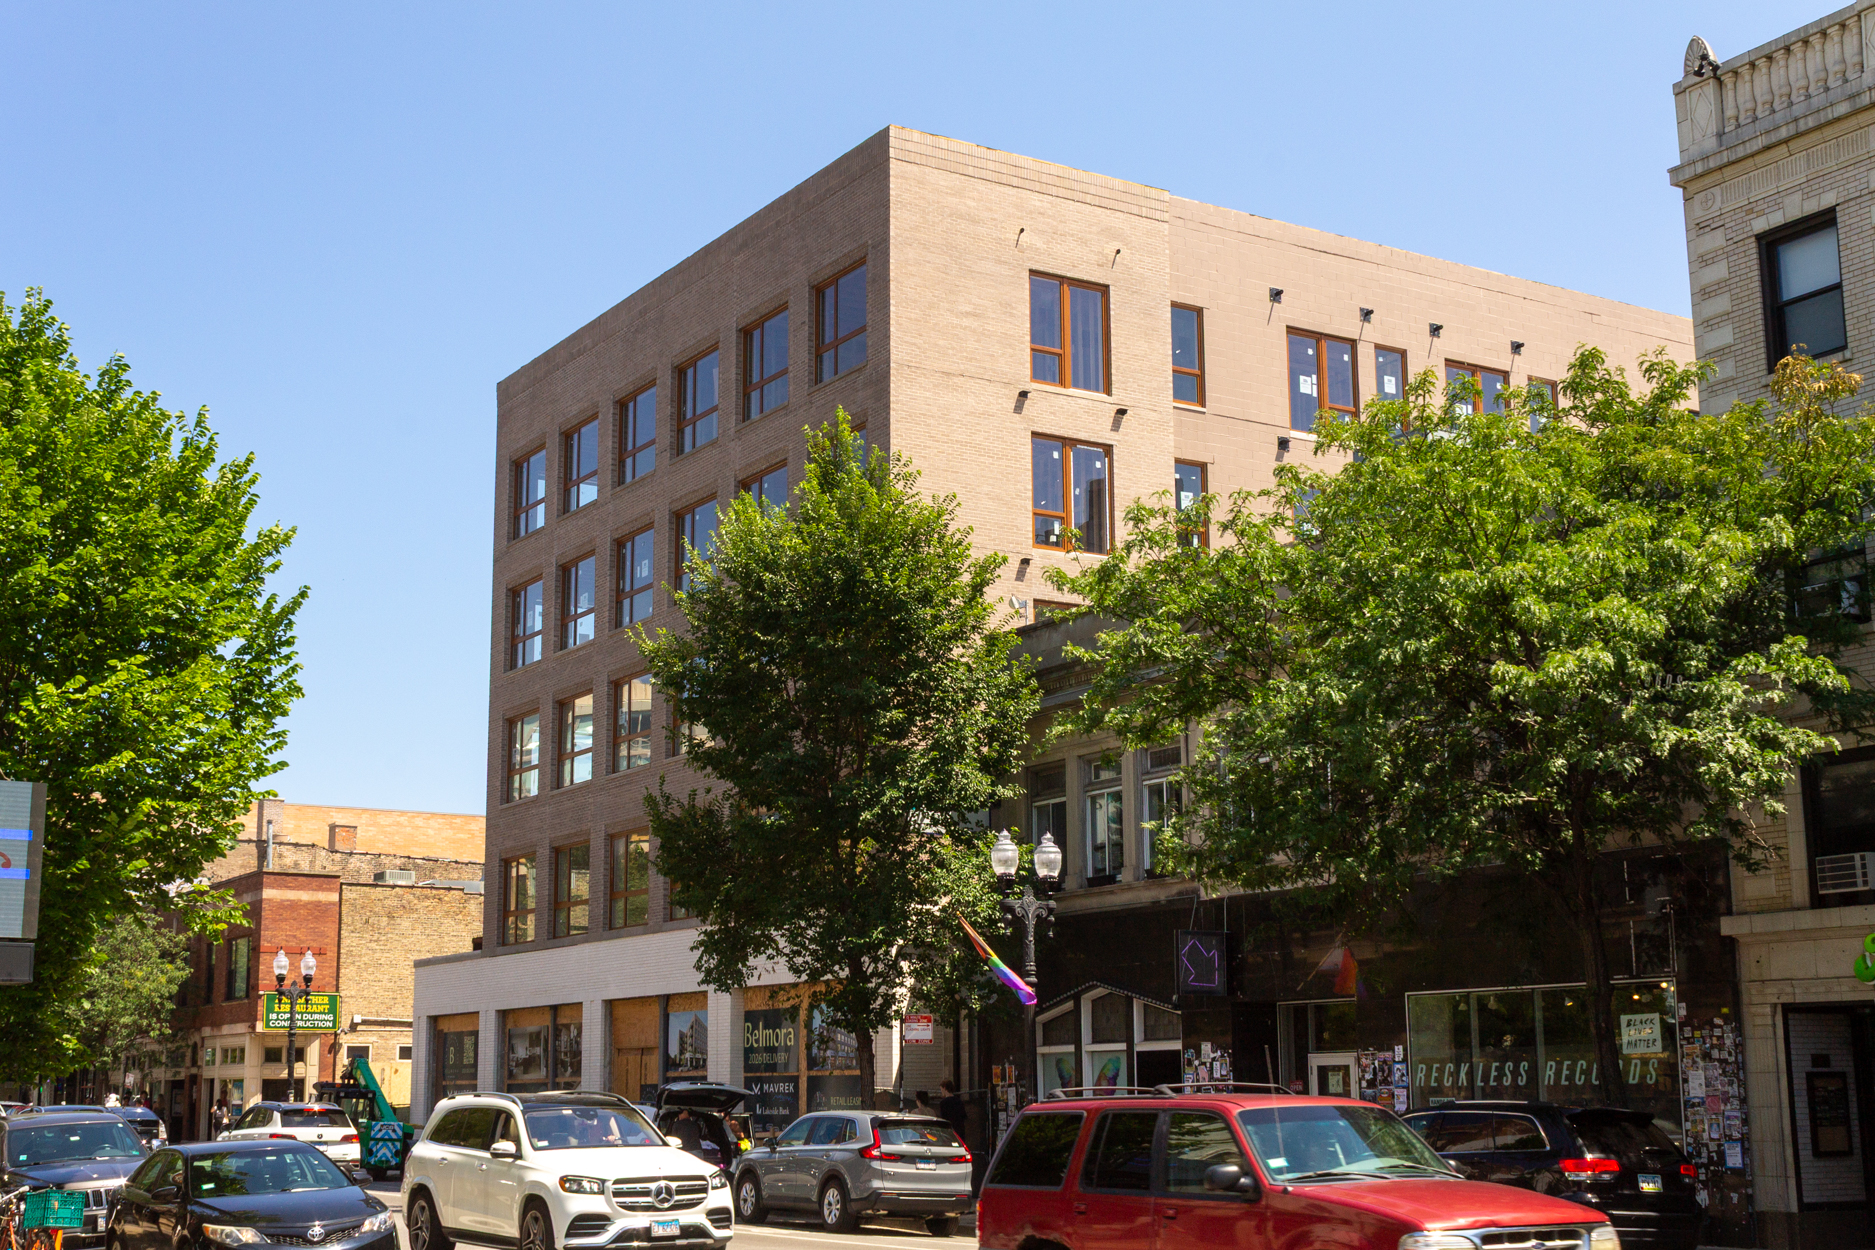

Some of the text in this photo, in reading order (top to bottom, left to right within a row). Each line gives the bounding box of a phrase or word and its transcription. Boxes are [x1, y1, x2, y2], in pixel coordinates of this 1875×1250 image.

[274, 1004, 330, 1012] RESAURANT
[302, 1013, 334, 1021] DURING
[1626, 1017, 1656, 1028] BLACK
[269, 1020, 333, 1028] CONRUCTION
[744, 1021, 795, 1048] Belmora
[1627, 1027, 1654, 1036] LIVES
[1626, 1038, 1657, 1050] MATTER
[748, 1052, 789, 1064] 2026 DELIVERY
[1415, 1061, 1529, 1087] RECKLESS
[1544, 1058, 1659, 1086] RECDS
[763, 1082, 795, 1093] MAVREK
[830, 1096, 847, 1106] RETAIL
